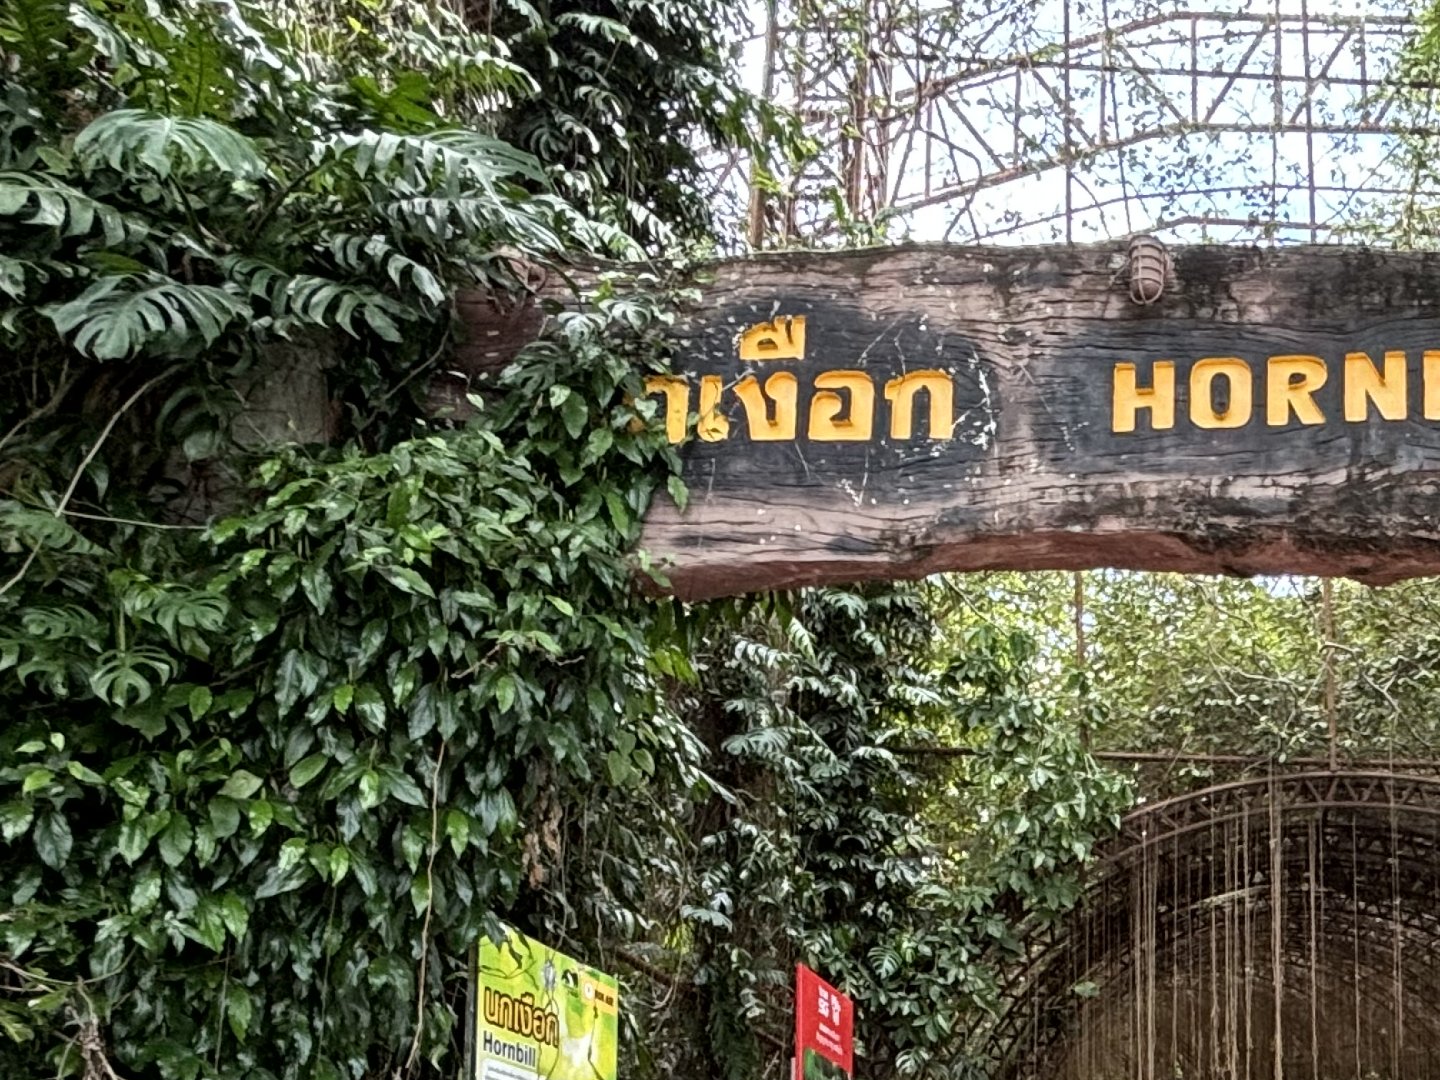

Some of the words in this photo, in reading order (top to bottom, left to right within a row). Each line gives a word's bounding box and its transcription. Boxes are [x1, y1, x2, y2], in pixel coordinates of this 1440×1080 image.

[484, 986, 560, 1049] นกเงือก
[483, 1030, 536, 1067] Hornbill
